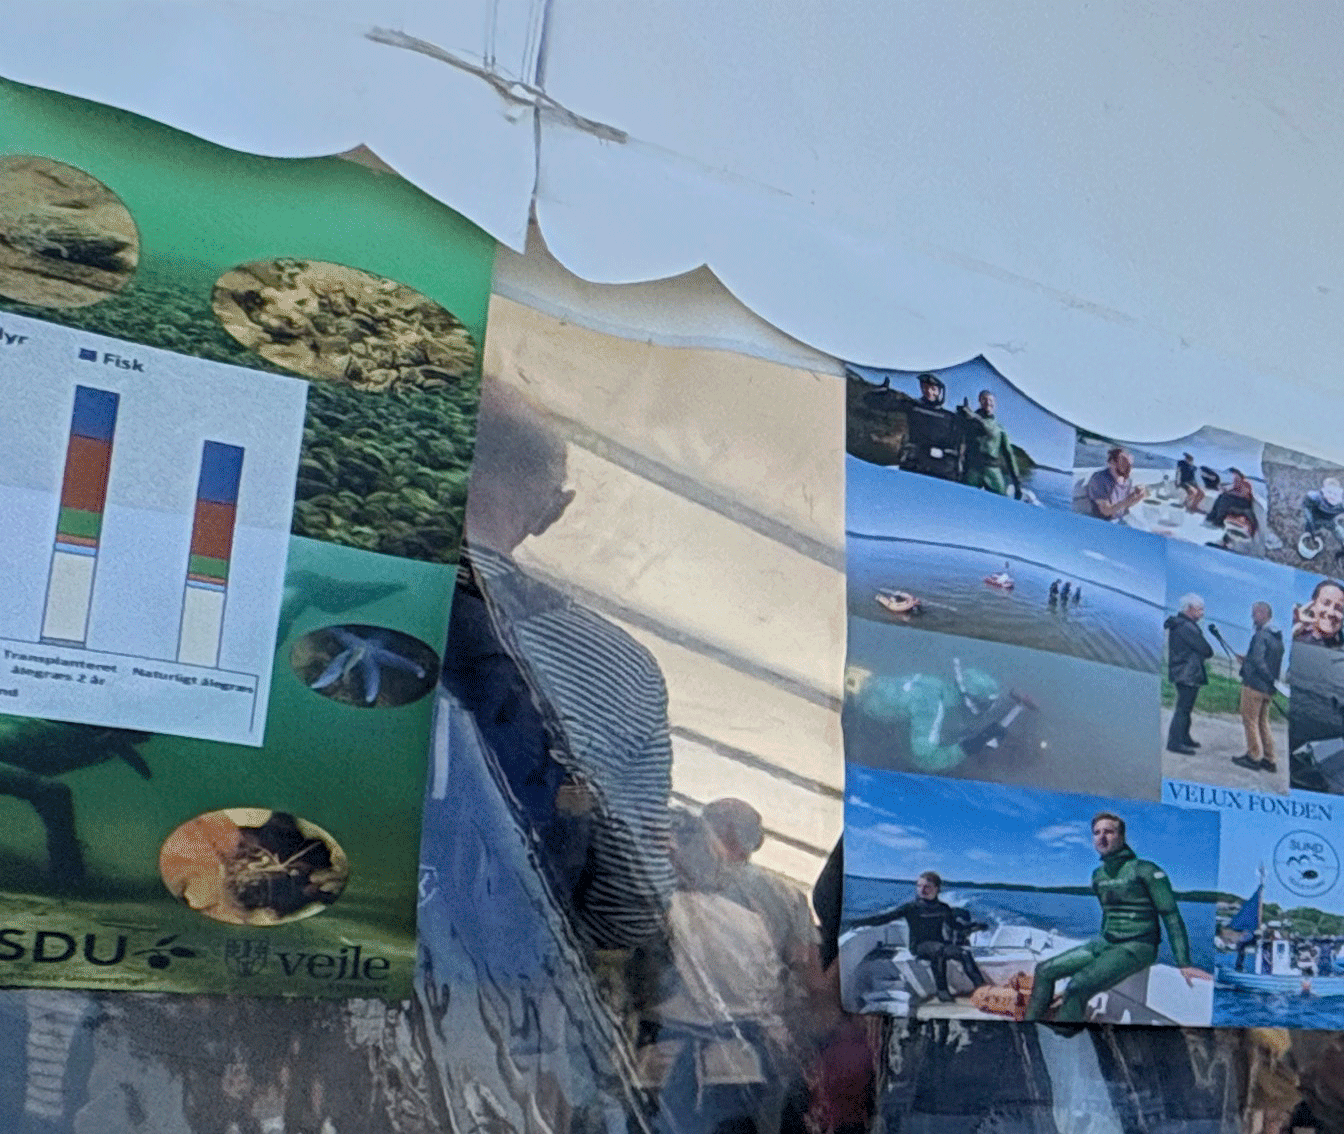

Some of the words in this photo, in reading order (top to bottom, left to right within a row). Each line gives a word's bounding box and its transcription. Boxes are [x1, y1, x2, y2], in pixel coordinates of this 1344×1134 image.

[103, 352, 144, 373] Fisk
[4, 649, 118, 674] Transplanteret
[76, 673, 87, 684] 2
[132, 667, 198, 686] Naturligt
[1168, 781, 1243, 810] VELUX
[1248, 794, 1334, 822] FONDEN
[0, 928, 128, 967] SDU
[276, 944, 391, 982] vejle
